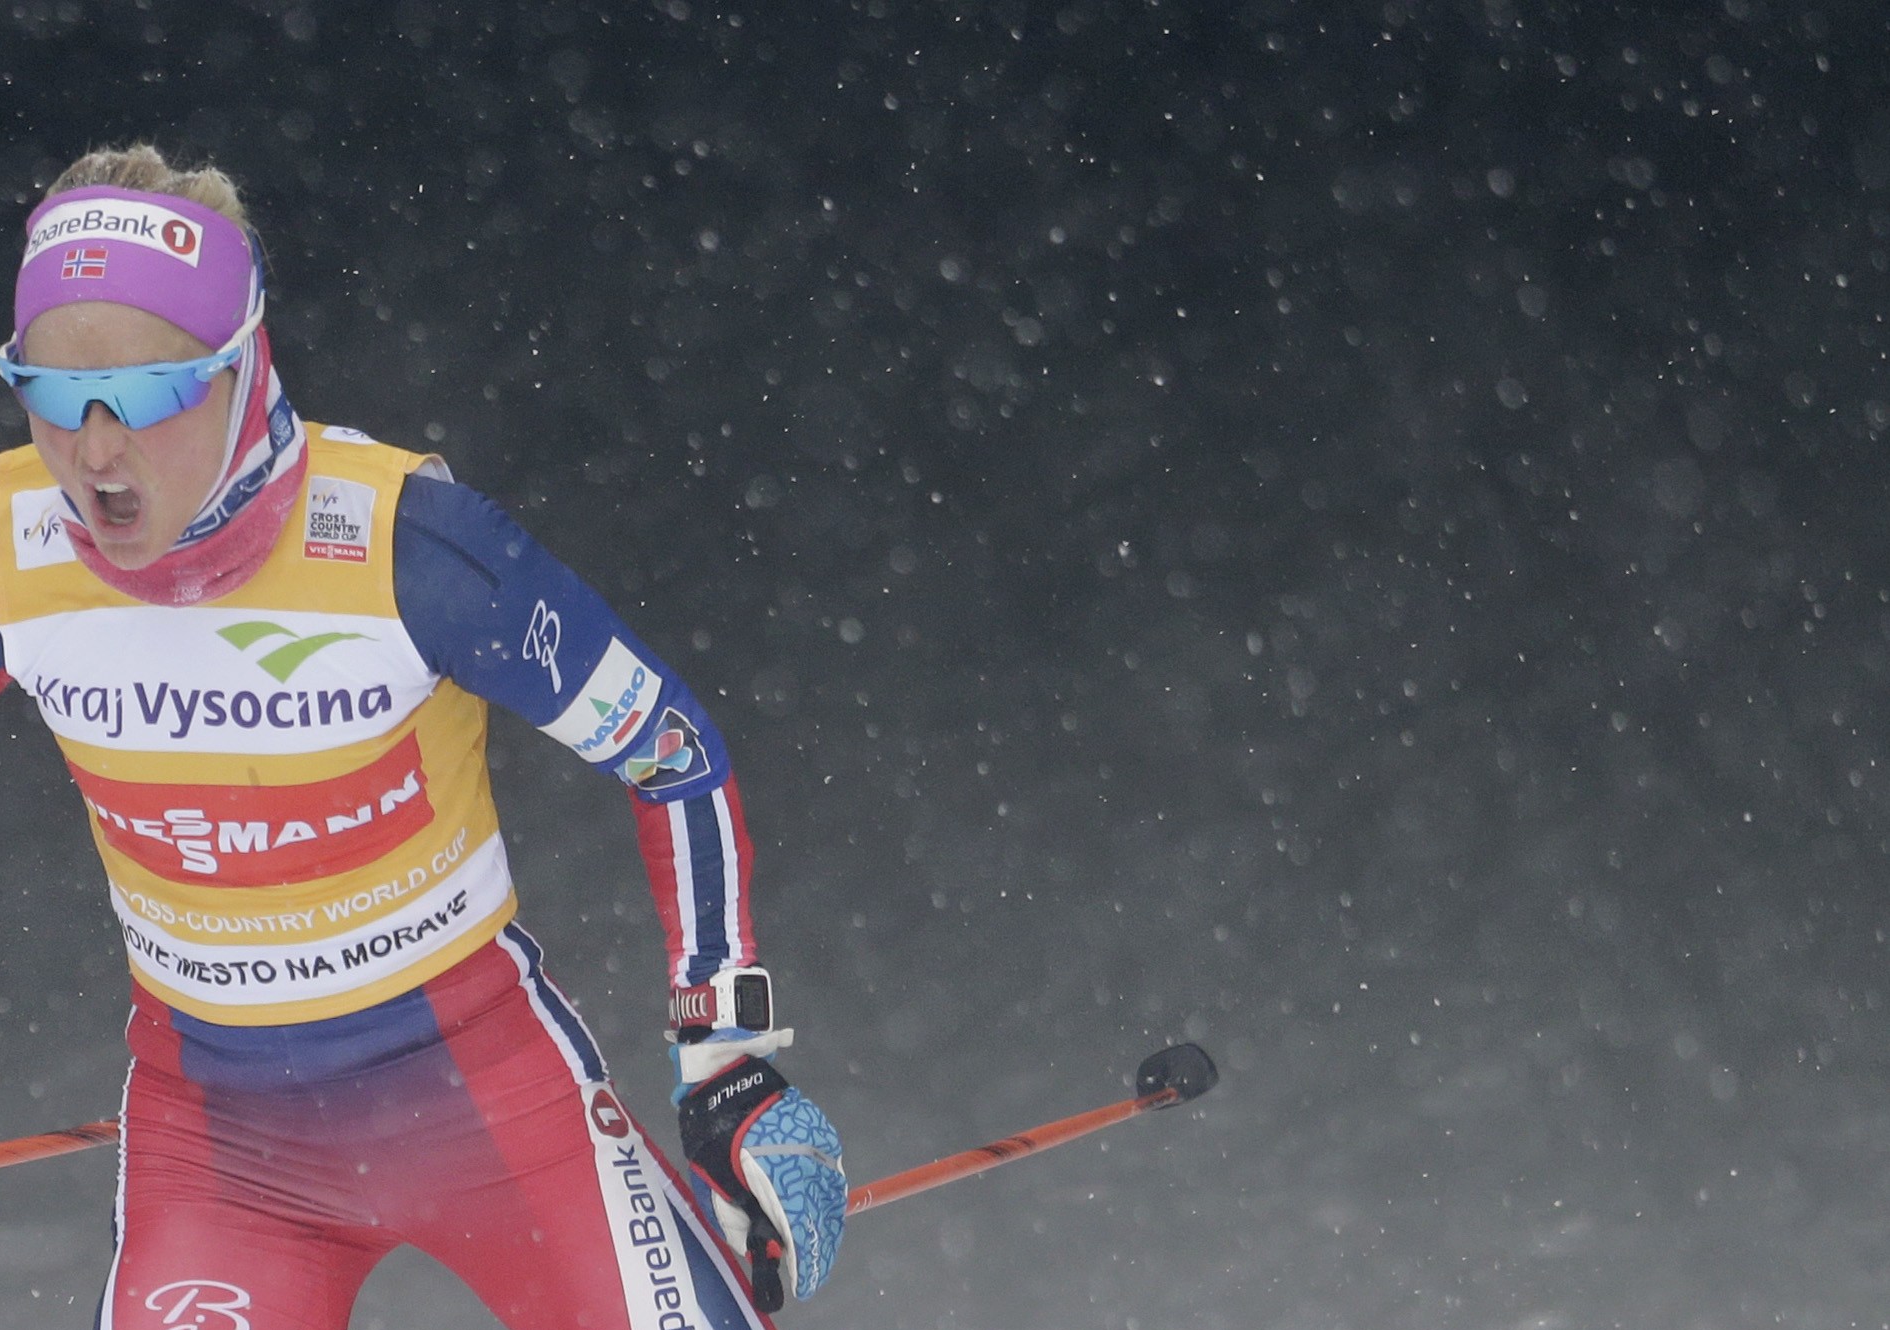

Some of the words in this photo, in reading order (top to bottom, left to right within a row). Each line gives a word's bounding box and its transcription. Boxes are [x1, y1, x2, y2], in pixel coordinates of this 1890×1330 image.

[310, 521, 361, 534] COUNTRY
[311, 512, 346, 524] CROSS
[310, 530, 339, 541] WORLD
[341, 533, 357, 542] CUP
[35, 675, 123, 739] Kraj
[573, 666, 646, 753] MAXBO
[119, 884, 314, 933] OSS-COUNTRY
[322, 867, 427, 924] WORLD
[432, 826, 467, 875] CUP
[285, 955, 337, 982] NA
[708, 1072, 764, 1111] DÆHLIE
